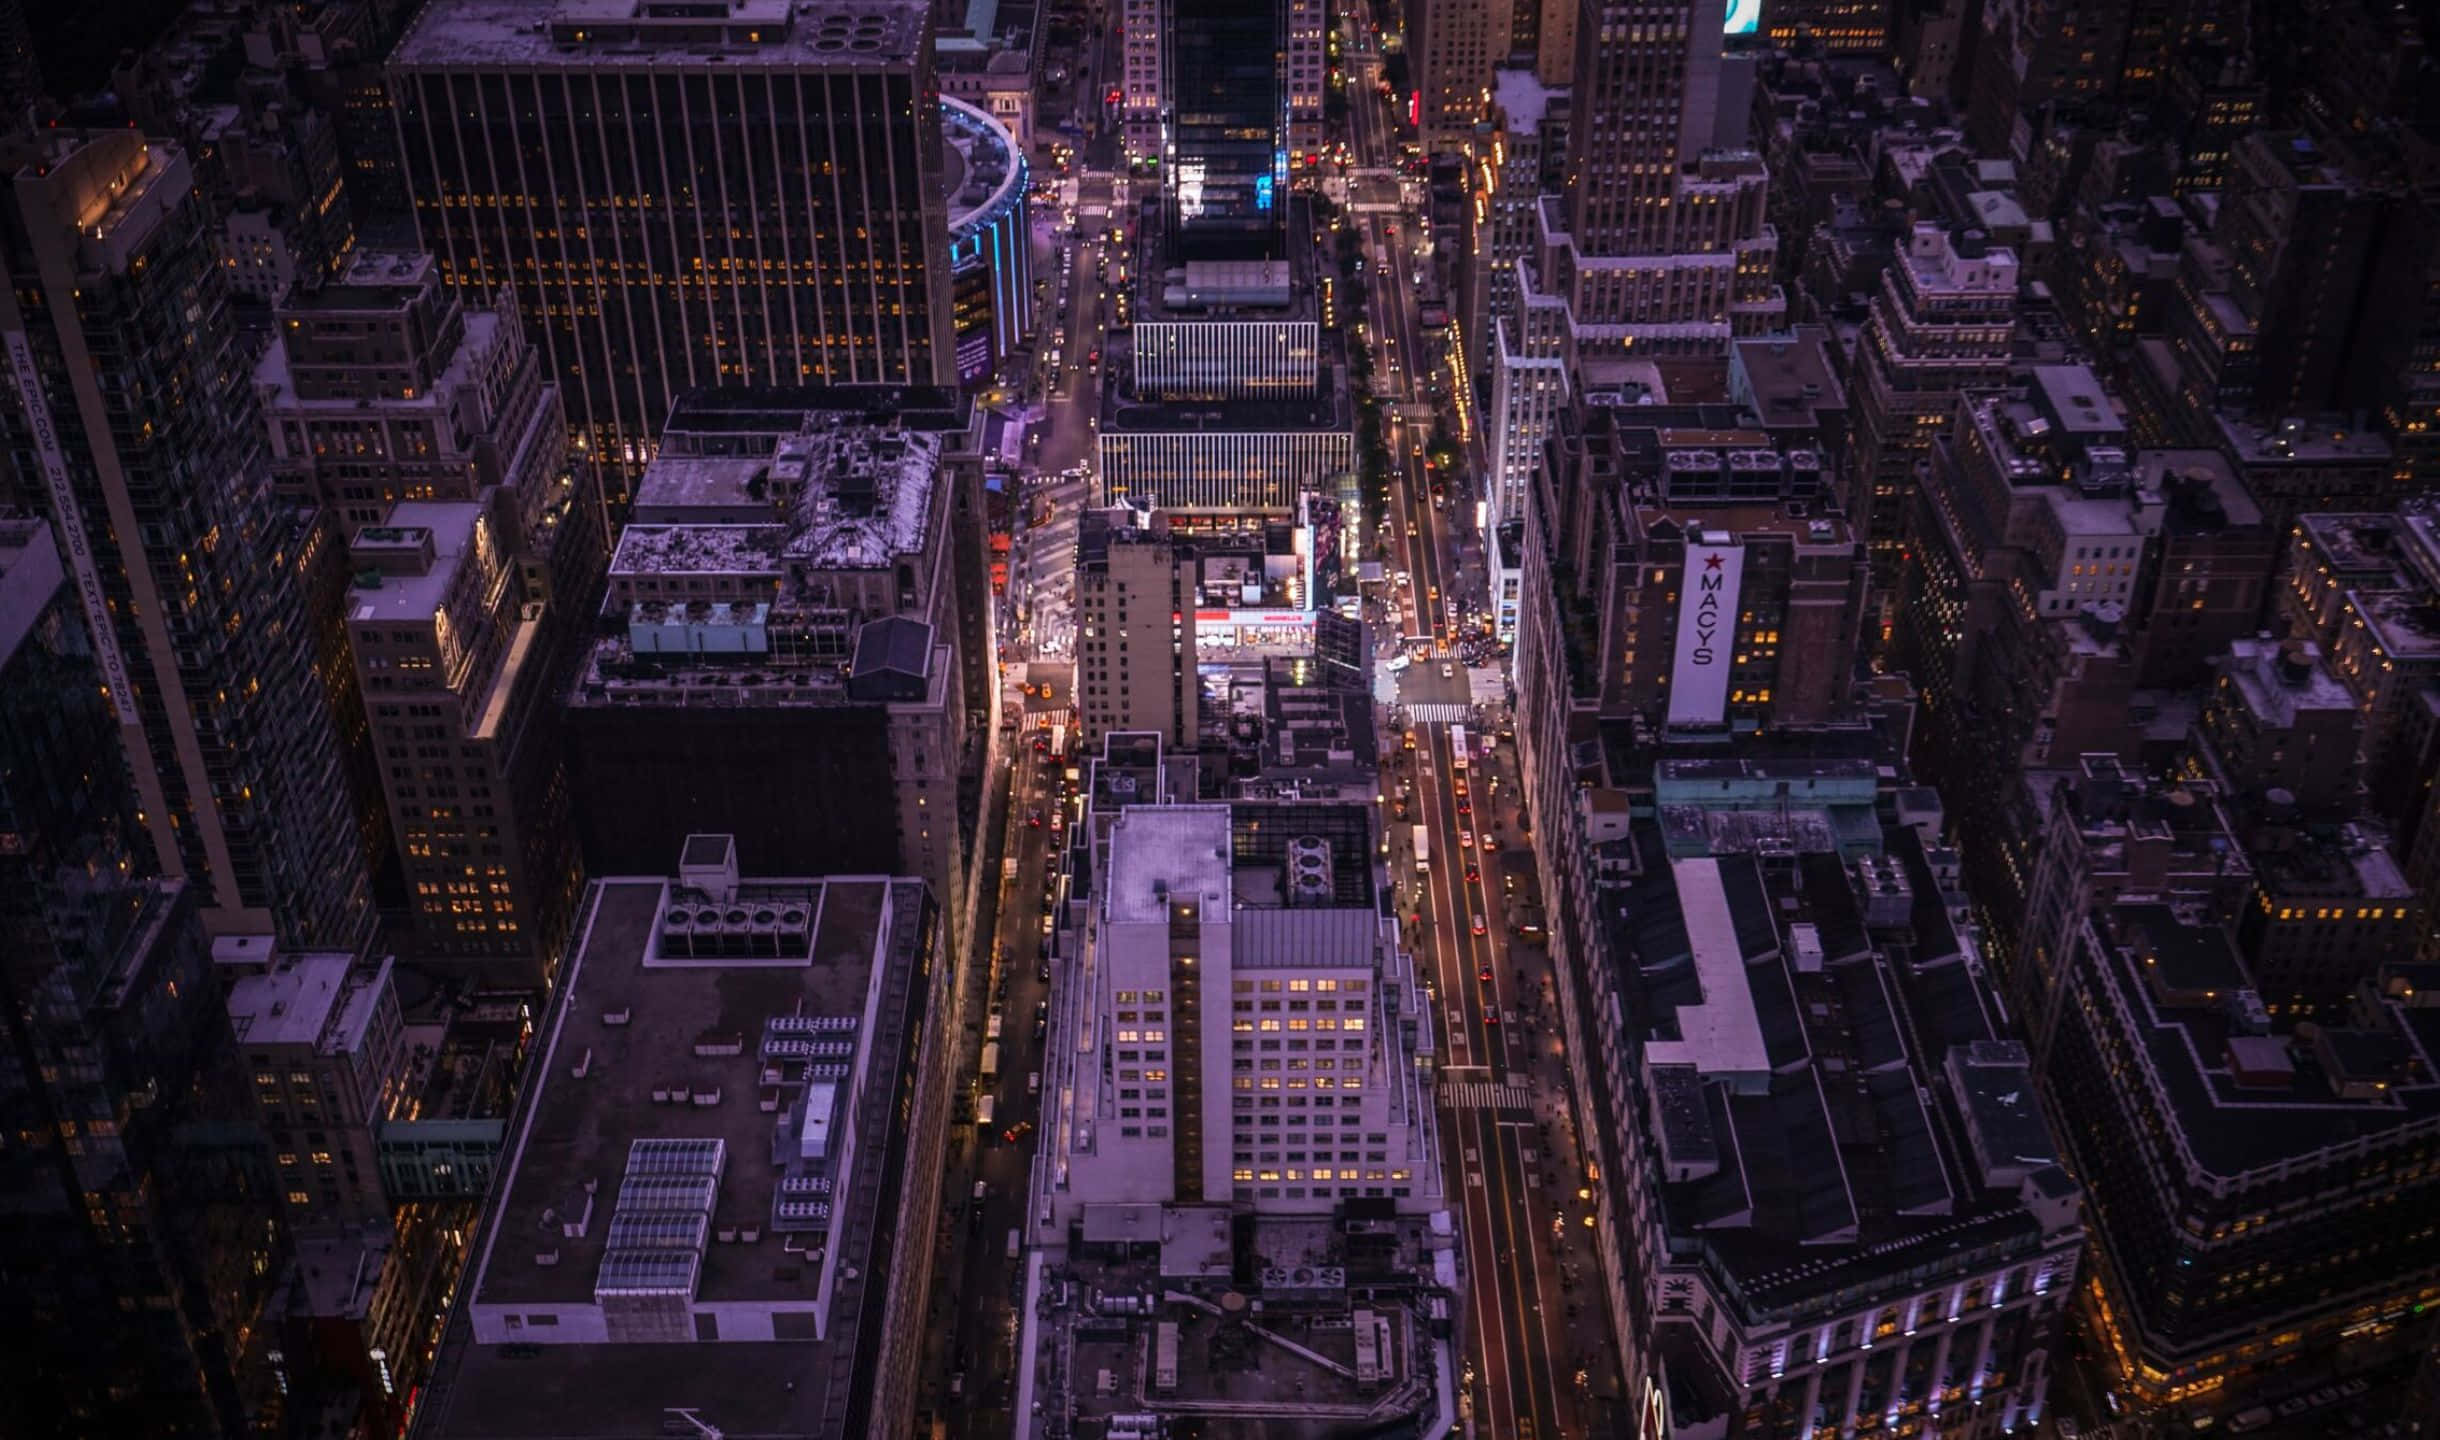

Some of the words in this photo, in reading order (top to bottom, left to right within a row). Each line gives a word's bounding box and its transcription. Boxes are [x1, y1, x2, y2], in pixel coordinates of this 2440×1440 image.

[14, 344, 31, 373] THE
[82, 571, 100, 606] TEXT
[106, 654, 119, 672] TO
